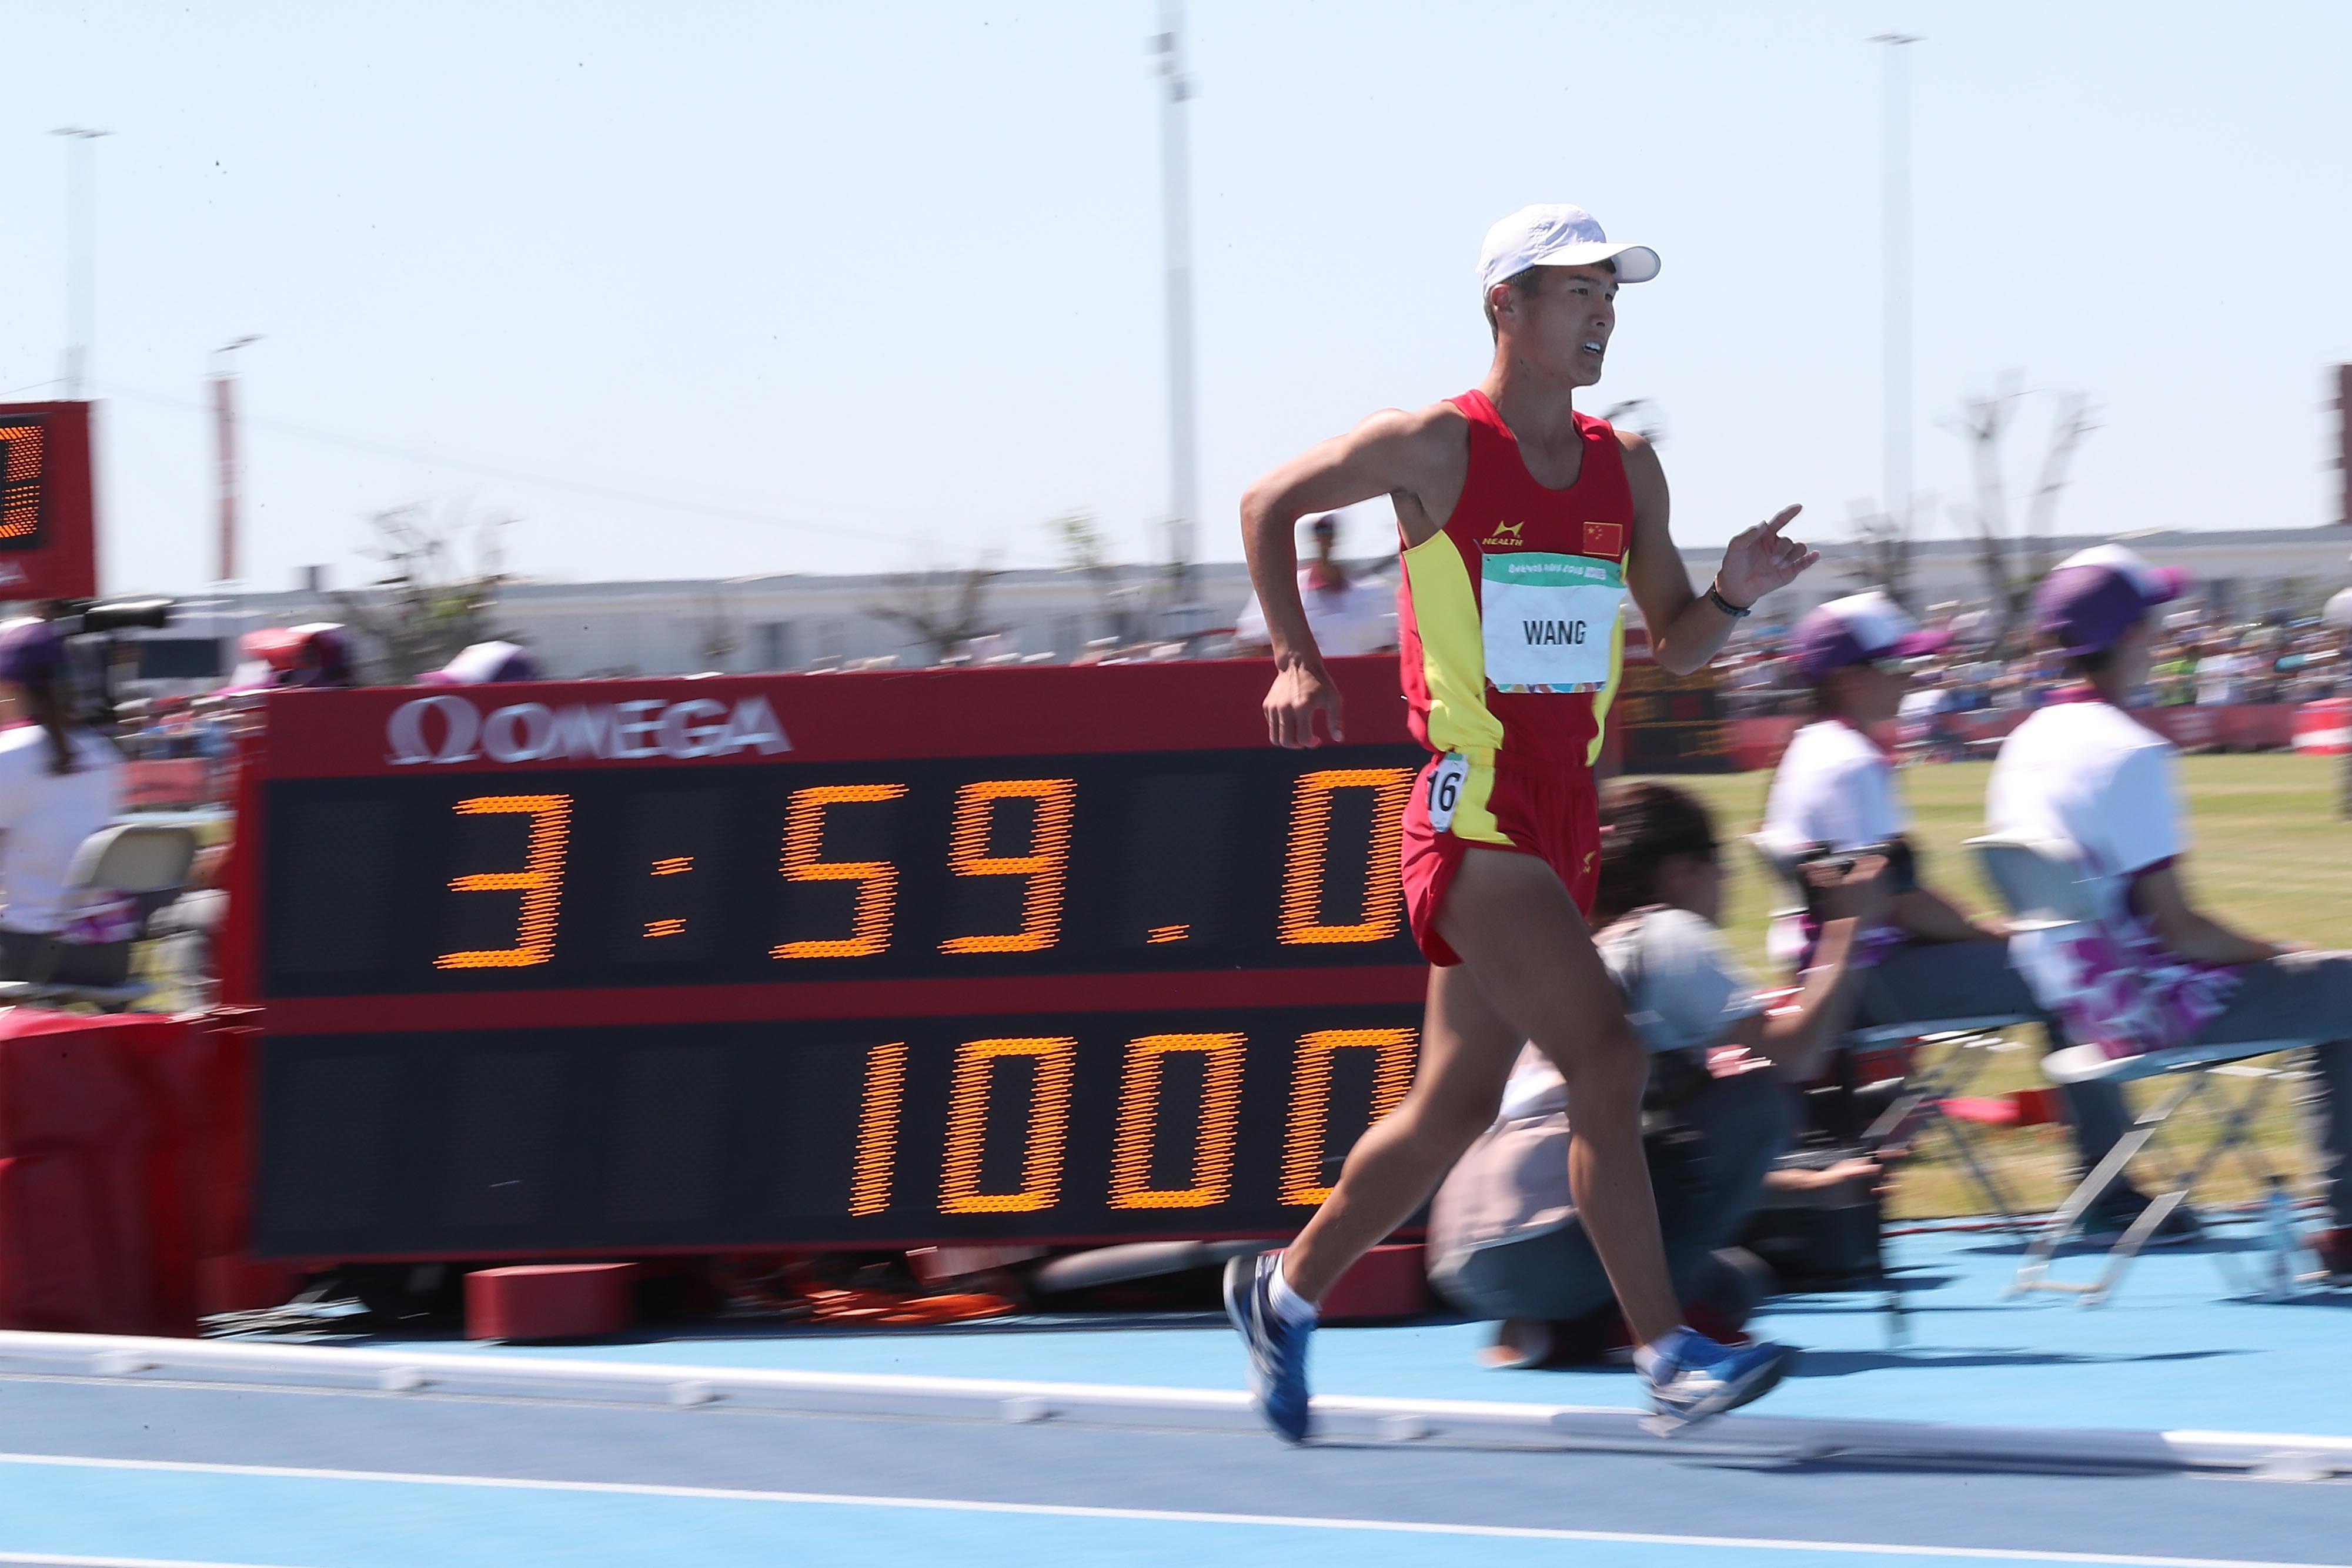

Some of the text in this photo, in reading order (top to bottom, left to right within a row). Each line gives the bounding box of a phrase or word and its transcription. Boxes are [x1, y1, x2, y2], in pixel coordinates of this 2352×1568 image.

[1482, 538, 1523, 546] HEALTH
[1524, 620, 1587, 646] WANG
[482, 694, 793, 763] OMEGA
[1427, 771, 1461, 811] 16
[847, 1028, 1420, 1216] 1000
